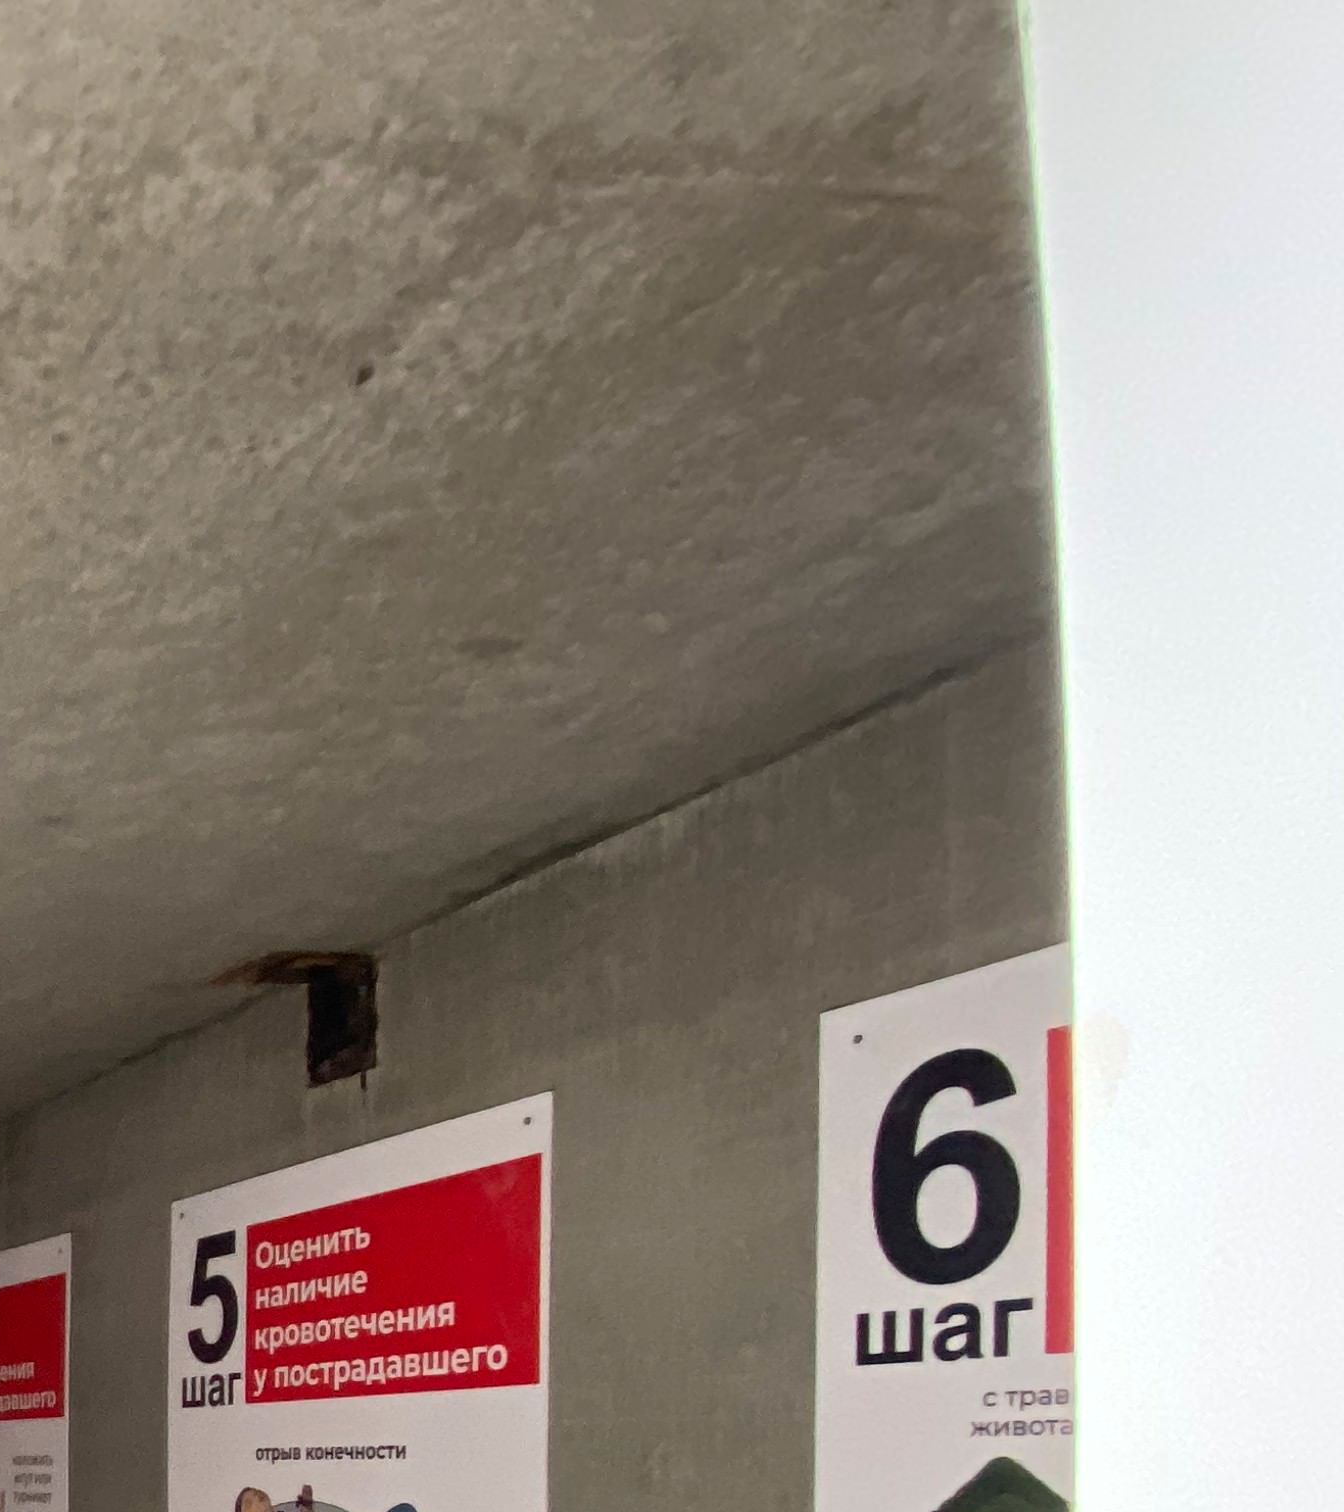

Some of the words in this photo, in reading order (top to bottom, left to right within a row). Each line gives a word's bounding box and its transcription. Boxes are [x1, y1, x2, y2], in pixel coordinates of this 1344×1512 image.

[871, 1047, 1021, 1286] 6
[255, 1226, 371, 1269] Оценить
[187, 1229, 239, 1365] 5
[255, 1270, 368, 1309] наличие
[255, 1301, 456, 1354] кровотечения
[855, 1298, 1034, 1366] шаг
[181, 1370, 242, 1409] шаг
[252, 1366, 267, 1397] у
[274, 1343, 508, 1390] пострадавшего
[983, 1391, 997, 1407] с
[970, 1419, 1073, 1437] живота
[255, 1447, 301, 1465] отрыв
[305, 1443, 407, 1461] конечности
